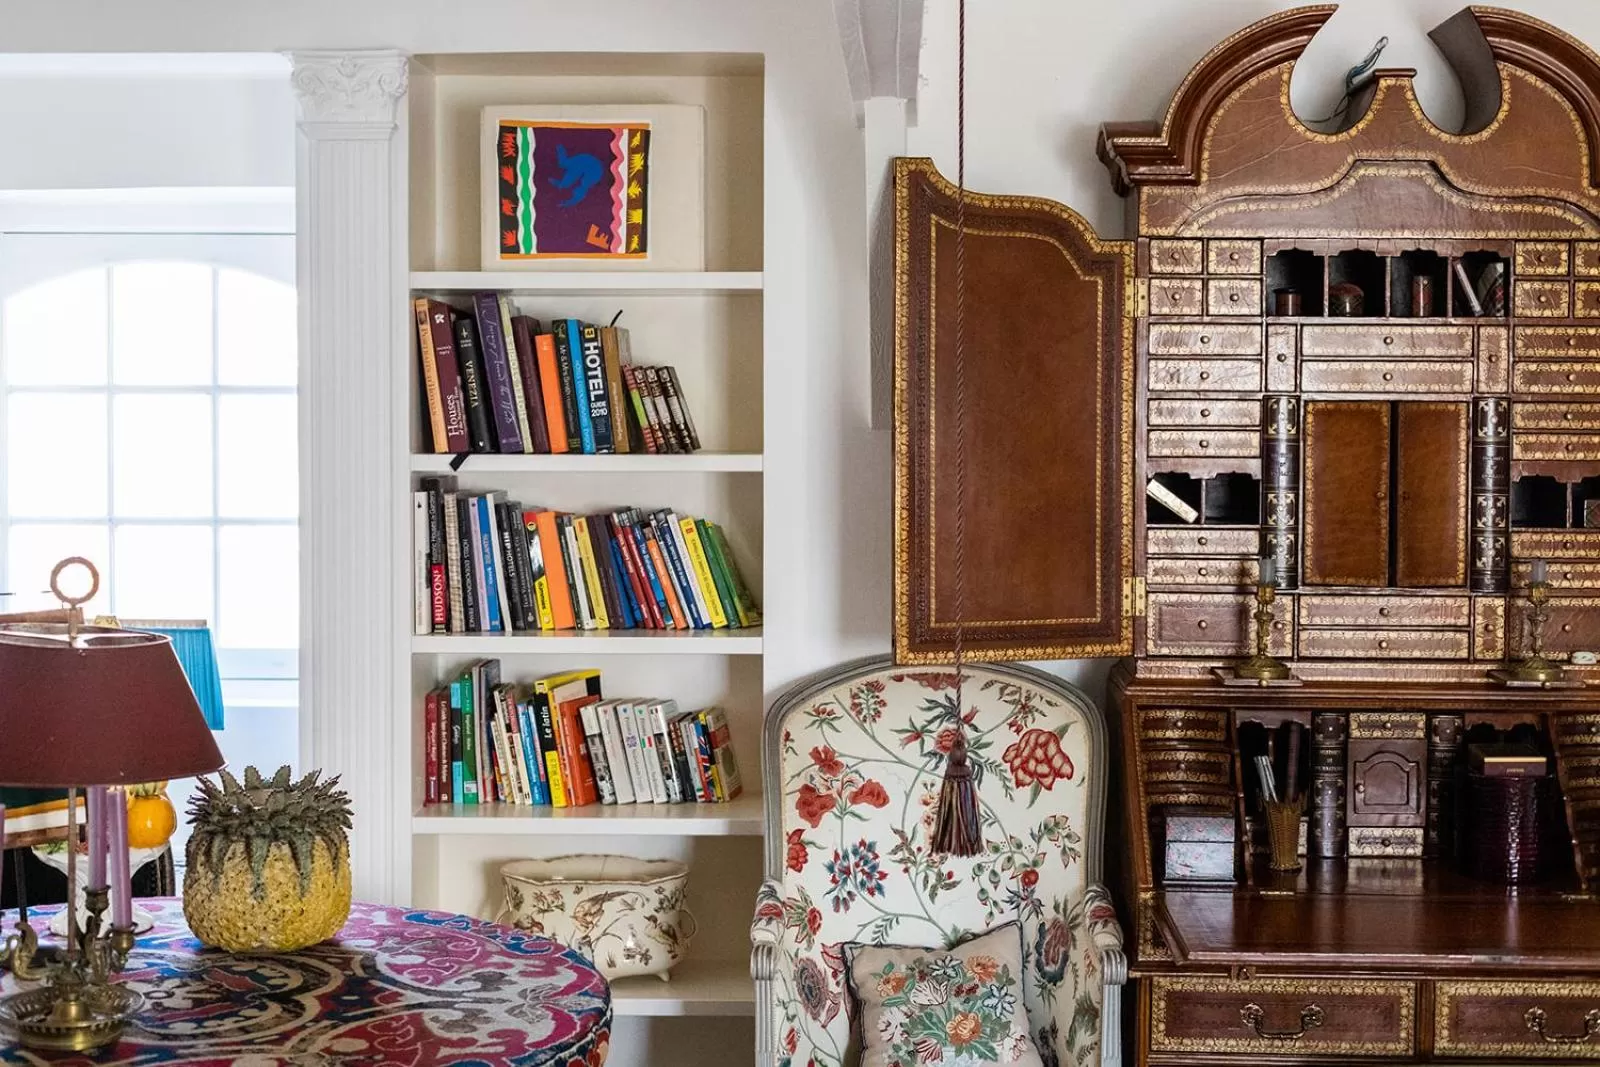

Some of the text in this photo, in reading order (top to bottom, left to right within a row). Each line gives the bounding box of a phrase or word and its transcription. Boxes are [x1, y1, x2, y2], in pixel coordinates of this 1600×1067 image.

[464, 360, 479, 408] VENEZIA
[504, 335, 527, 418] HOTEL STORIES
[584, 341, 604, 401] HOTEL
[447, 394, 460, 437] Houses
[591, 409, 607, 417] 2010
[502, 531, 511, 549] HIP
[505, 549, 515, 577] HOTELS
[536, 580, 549, 609] dummies
[539, 704, 552, 738] Le latin
